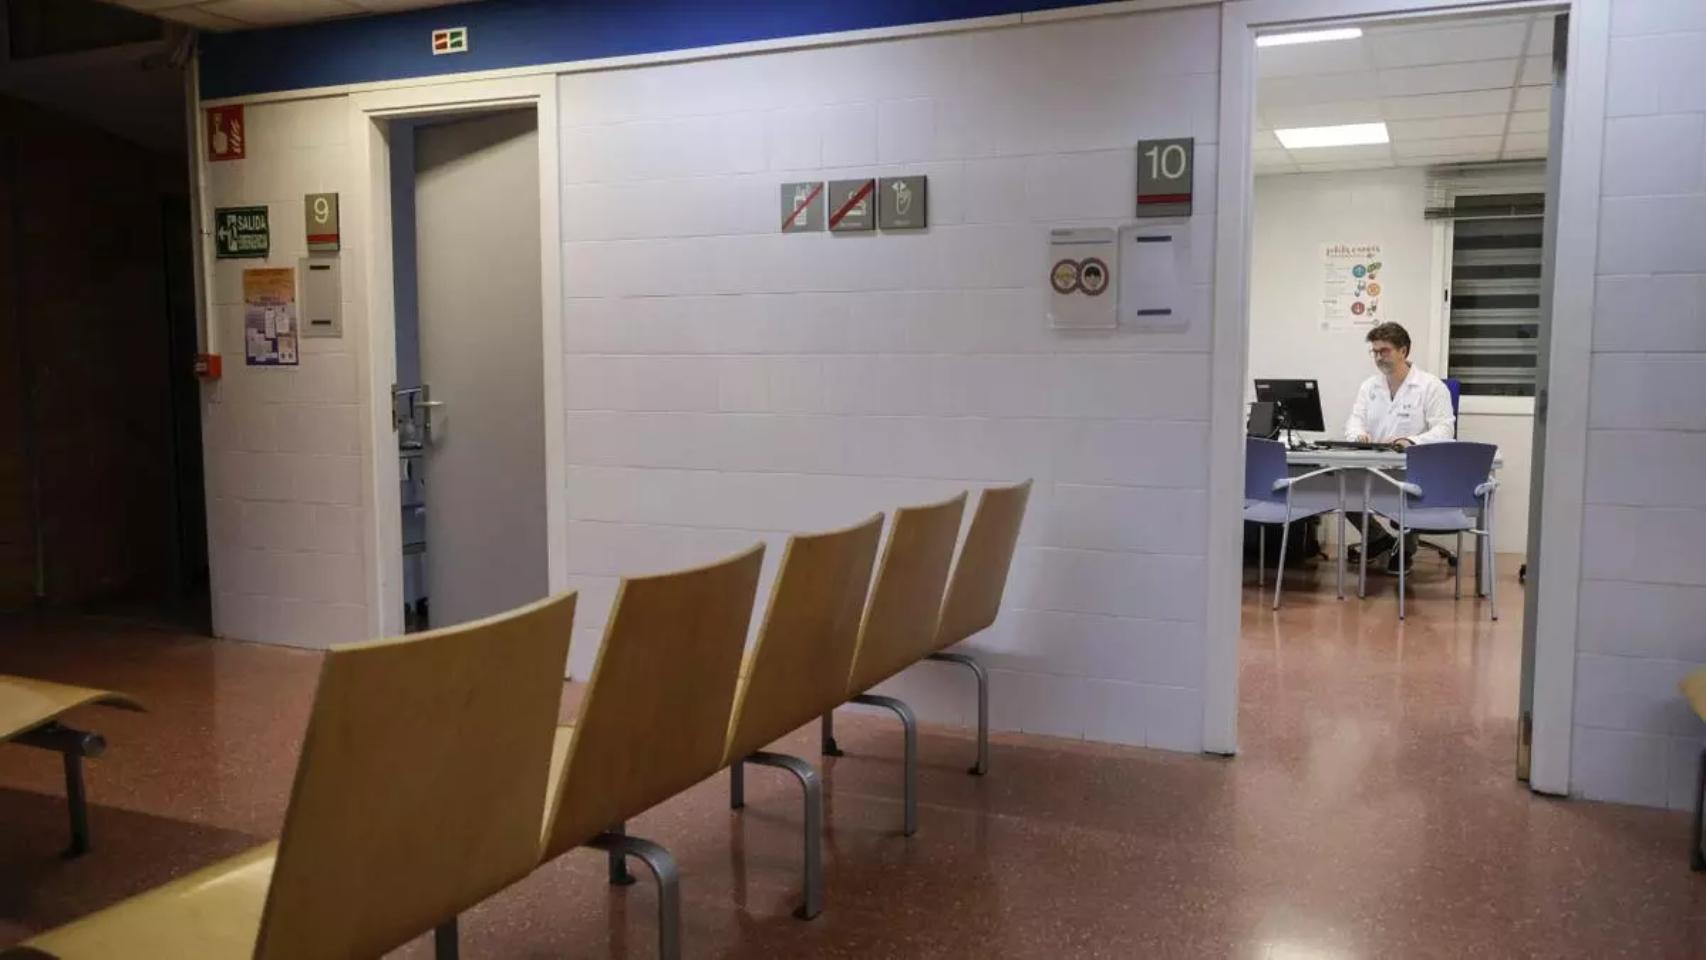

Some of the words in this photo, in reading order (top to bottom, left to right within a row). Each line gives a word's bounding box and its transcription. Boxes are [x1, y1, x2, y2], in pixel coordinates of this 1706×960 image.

[1144, 144, 1186, 179] 10
[238, 215, 267, 230] SALIDA
[314, 197, 329, 224] 9
